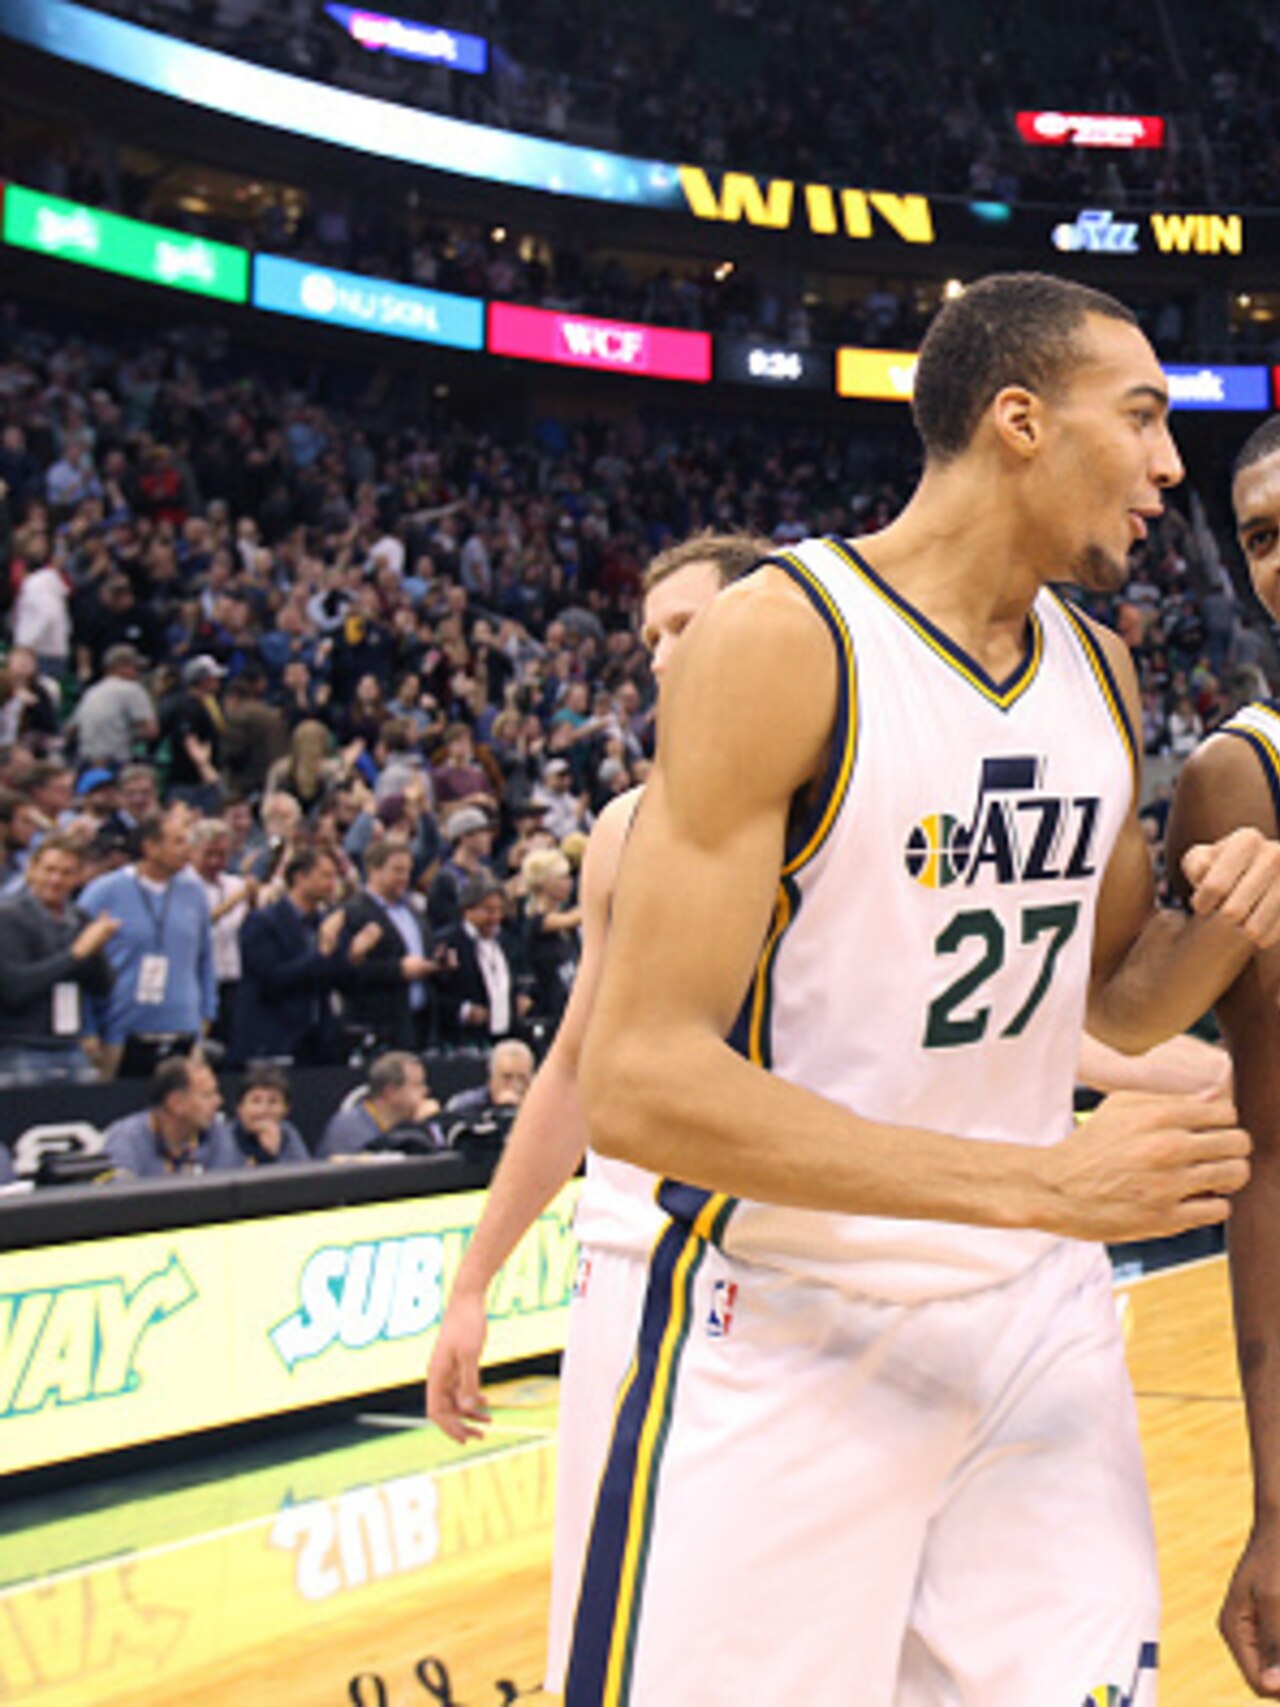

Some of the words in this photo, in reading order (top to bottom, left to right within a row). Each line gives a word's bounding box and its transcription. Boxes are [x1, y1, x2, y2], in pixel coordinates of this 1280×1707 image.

[678, 164, 934, 243] WIN
[1151, 213, 1243, 255] WIN
[561, 322, 643, 364] WCF
[904, 756, 1102, 889] JAZZ
[922, 901, 1081, 1048] 27
